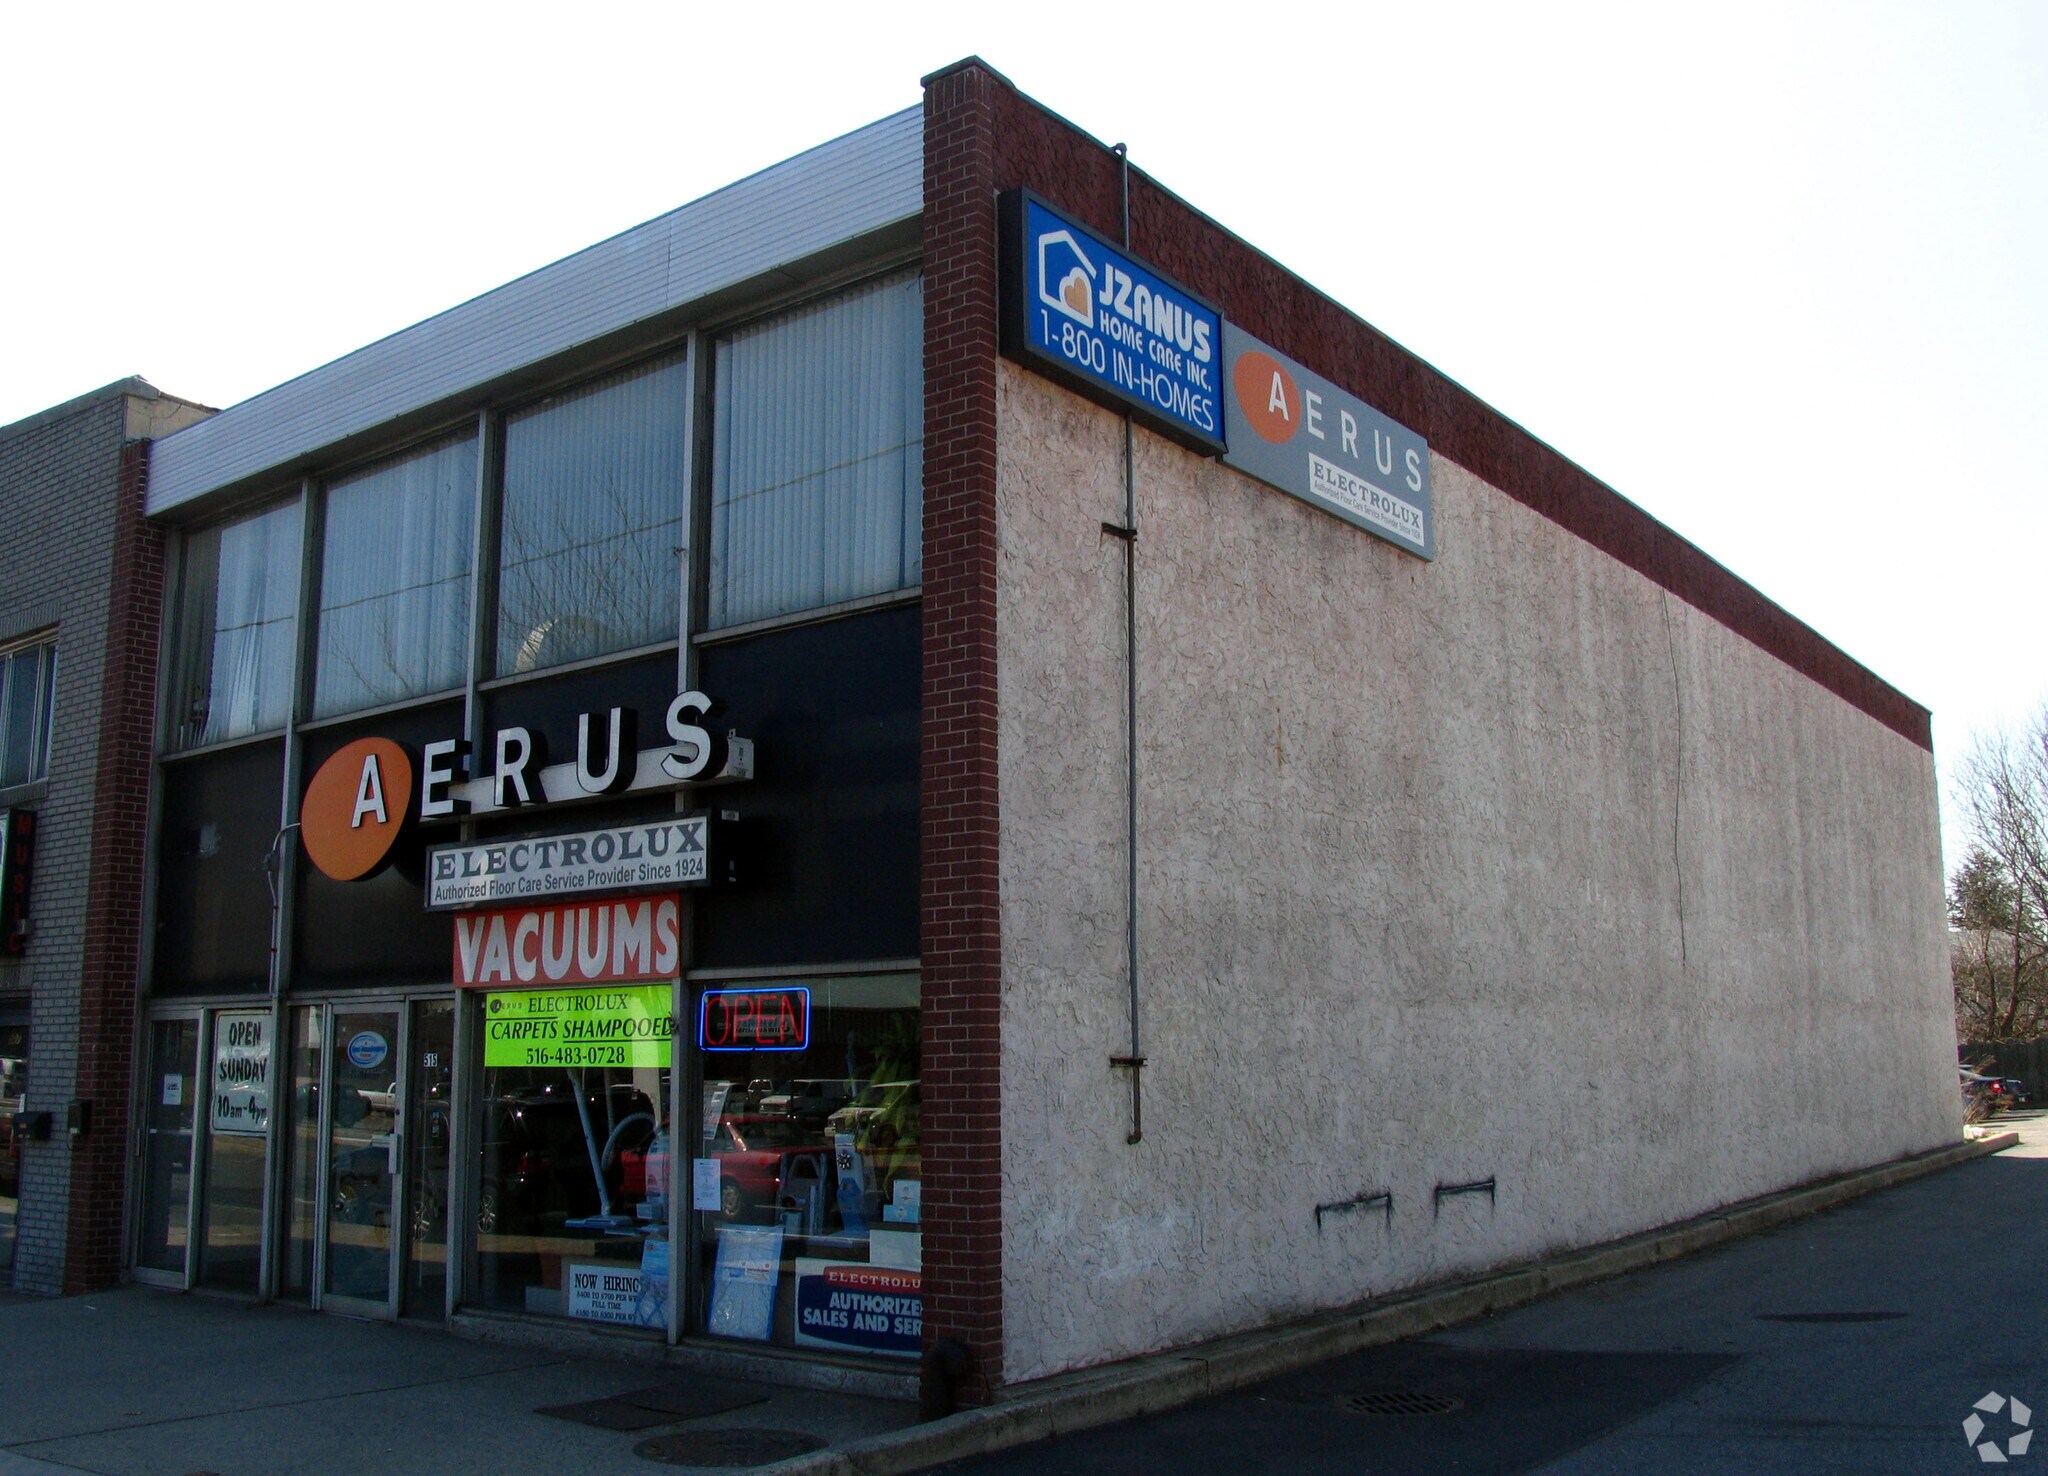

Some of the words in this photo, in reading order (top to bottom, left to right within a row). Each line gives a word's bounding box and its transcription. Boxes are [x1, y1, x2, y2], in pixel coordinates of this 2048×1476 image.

[1099, 263, 1211, 363] JZANUS
[1100, 309, 1144, 355] HOME
[1148, 339, 1182, 376] CARE
[1187, 359, 1212, 393] INC.
[1040, 308, 1106, 374] 1-800
[1112, 348, 1214, 431] IN-HOMES
[1268, 371, 1422, 492] AERUS
[1313, 461, 1421, 529] ELECTROLUX
[350, 690, 713, 828] AERUS
[434, 821, 704, 881] ELECTROLUX
[435, 880, 487, 901] Authorized
[489, 877, 516, 896] Floor
[518, 875, 542, 893] Care
[544, 872, 584, 890] Service
[587, 864, 636, 886] Provider
[638, 861, 672, 881] Since
[675, 857, 703, 877] 1924
[456, 899, 679, 983] VACUUMS
[528, 993, 628, 1013] ELECTROLUX
[491, 1020, 558, 1040] CARPETS
[562, 1017, 672, 1039] SHAMPOOED
[704, 991, 806, 1046] OPEN
[229, 1021, 261, 1046] OPEN
[424, 1053, 438, 1067] 515
[526, 1046, 625, 1065] 516-483-0728
[219, 1058, 267, 1083] SUNDAY
[575, 1273, 598, 1289] NOW
[603, 1275, 641, 1293] HIRING
[592, 1291, 600, 1299] TO
[615, 1293, 627, 1302] PER
[592, 1300, 606, 1308] FULL
[608, 1302, 622, 1310] TIME
[591, 1309, 599, 1317] TO
[803, 1307, 849, 1329] SALES
[852, 1312, 889, 1332] AND
